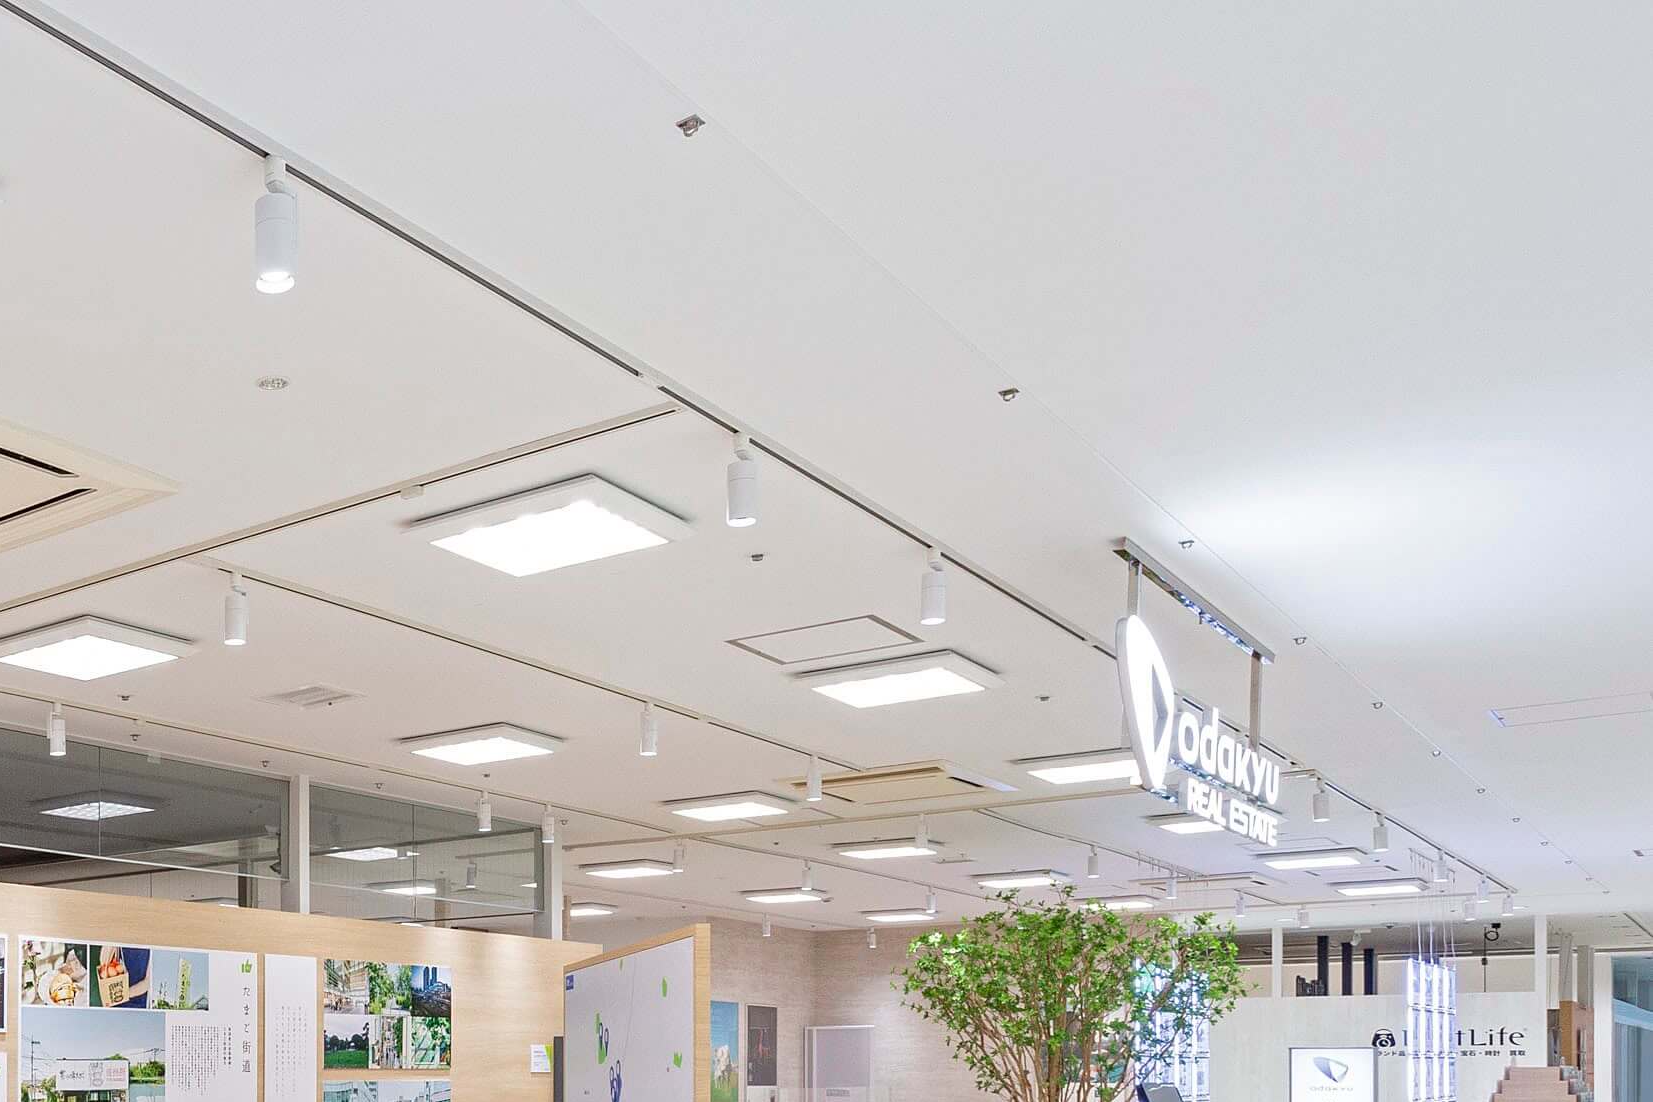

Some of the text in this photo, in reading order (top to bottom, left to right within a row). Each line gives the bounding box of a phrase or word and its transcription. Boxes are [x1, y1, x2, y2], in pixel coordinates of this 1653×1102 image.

[1177, 706, 1280, 805] odakyu
[1187, 777, 1279, 848] REAL ESTATE
